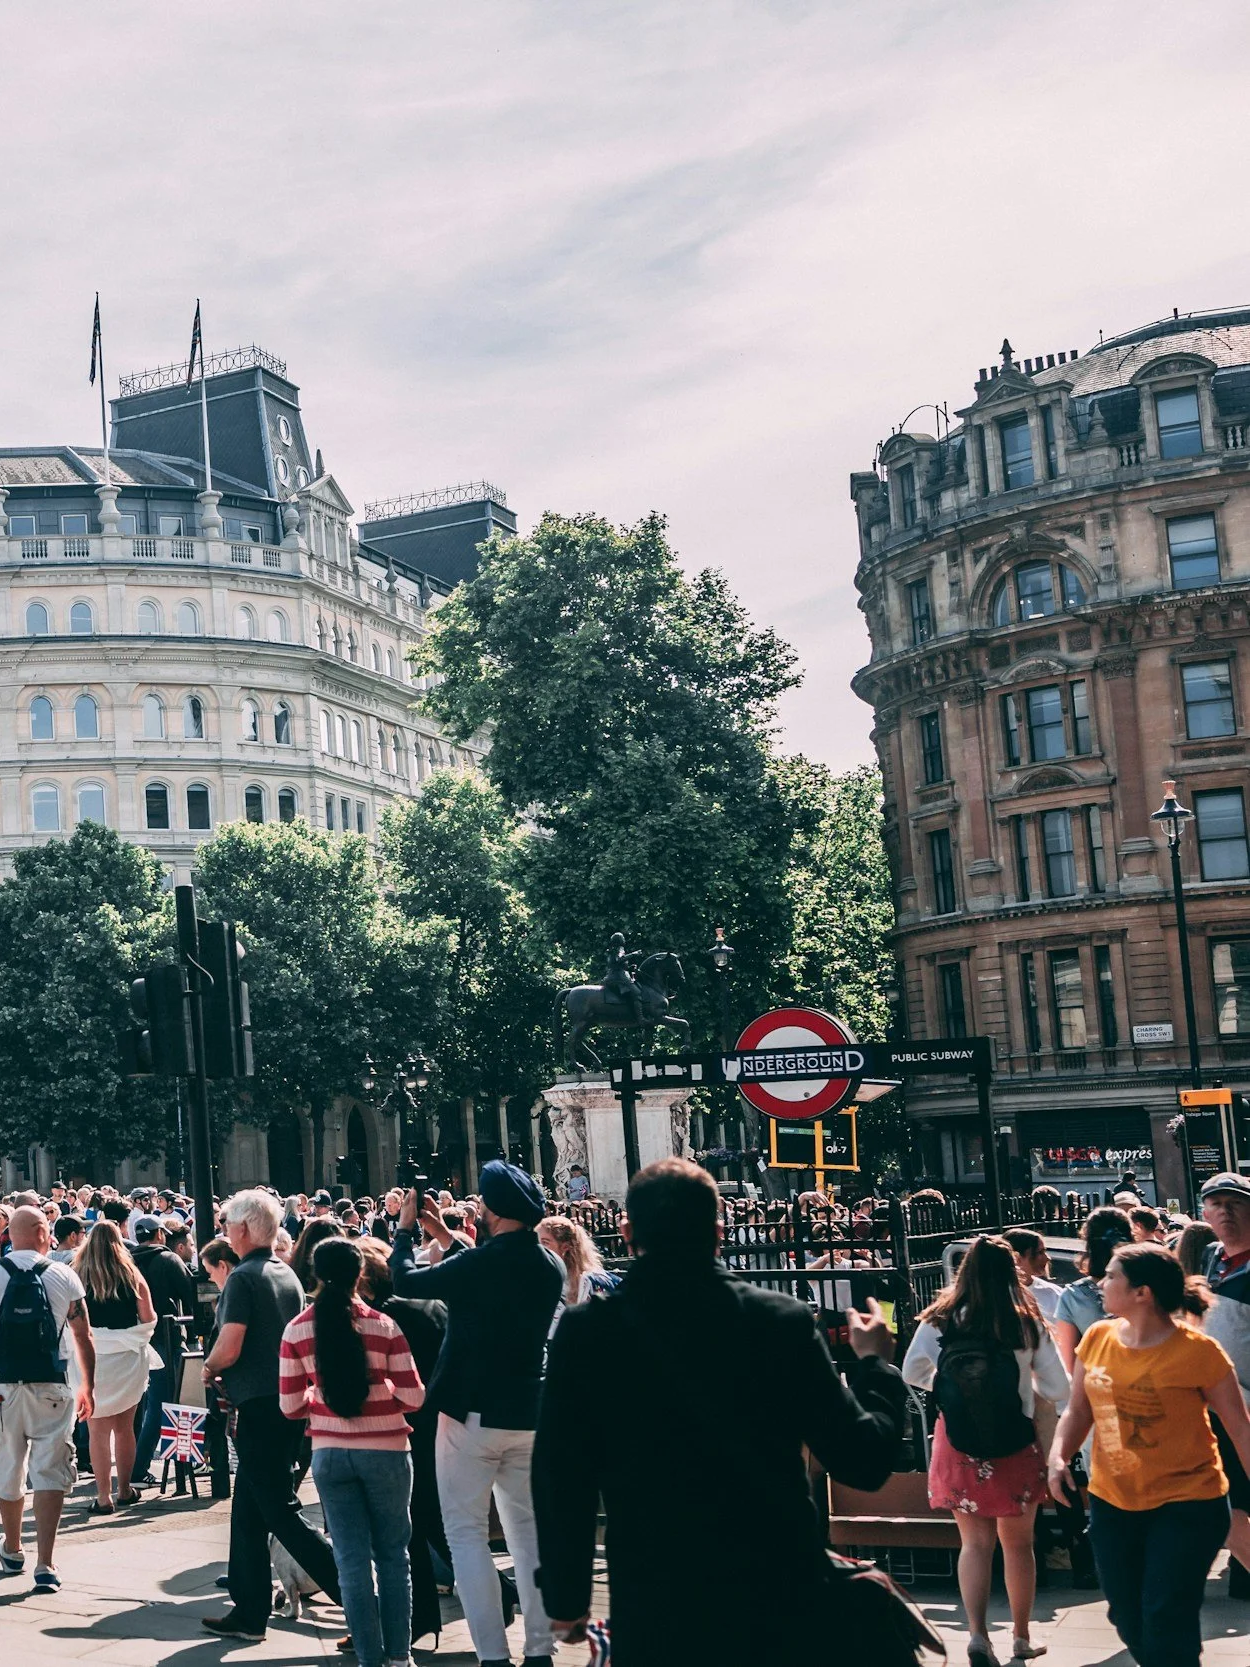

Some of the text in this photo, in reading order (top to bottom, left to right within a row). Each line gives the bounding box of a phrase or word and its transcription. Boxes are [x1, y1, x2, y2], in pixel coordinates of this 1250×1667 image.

[721, 1050, 865, 1078] UNDERGROUND
[891, 1050, 974, 1062] PUBLIC SUBWAY
